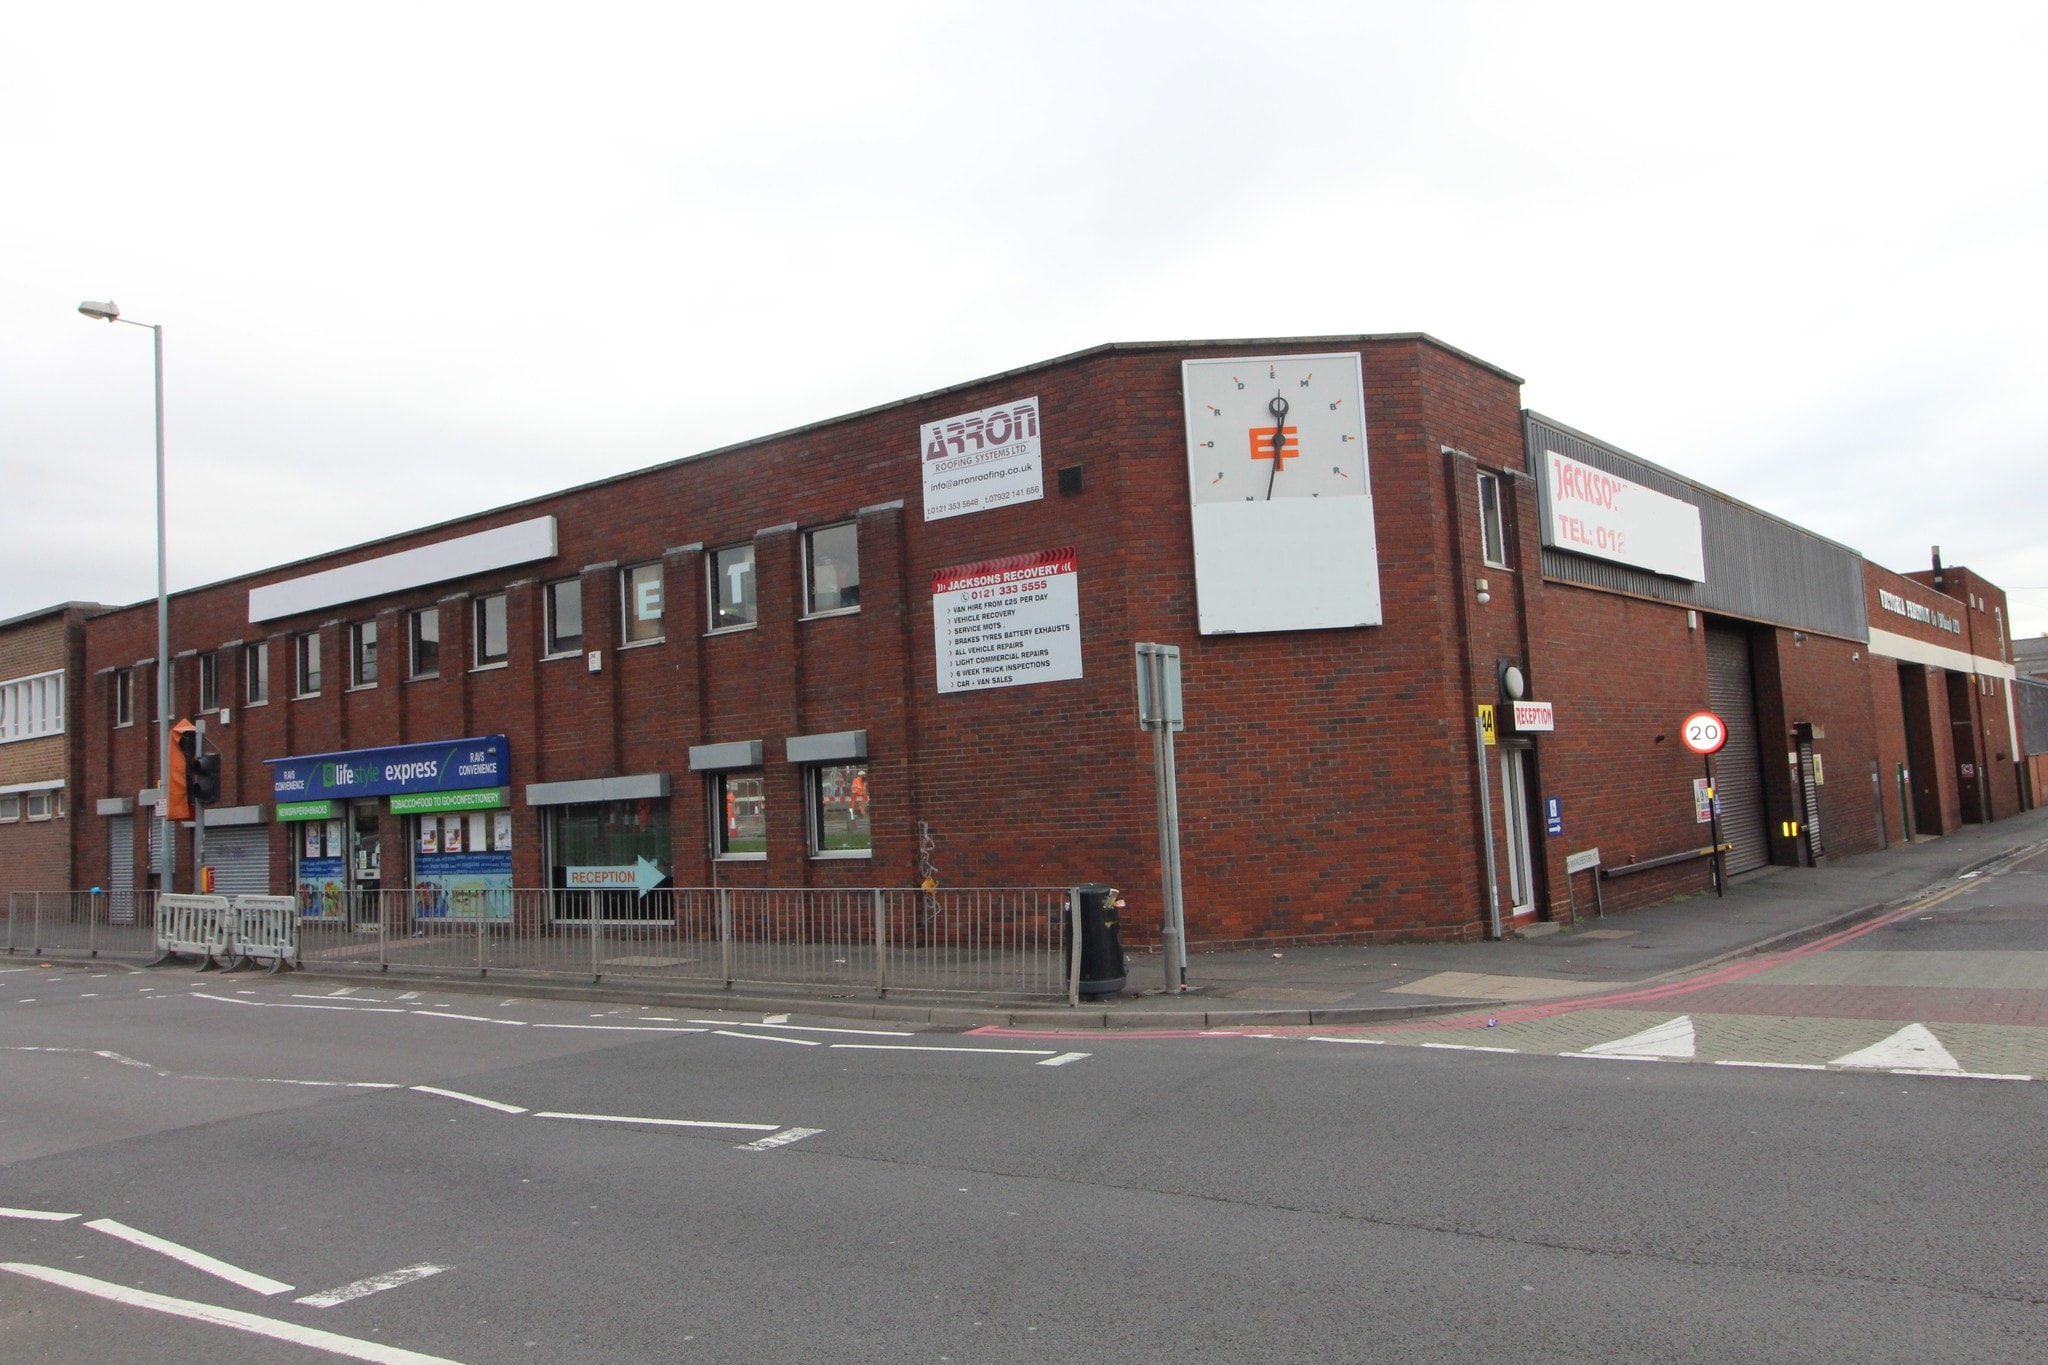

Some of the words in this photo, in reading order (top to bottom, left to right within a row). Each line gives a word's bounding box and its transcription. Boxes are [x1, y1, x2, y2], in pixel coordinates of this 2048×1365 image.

[926, 404, 1037, 461] ARRON
[935, 457, 973, 472] ROOFING
[975, 447, 1010, 463] SYSTEMS
[1011, 444, 1027, 455] LTD
[930, 463, 1033, 491] info@arronroofing.co.uk
[948, 501, 961, 511] 353
[1012, 489, 1024, 498] 141
[1026, 485, 1040, 495] 656
[1558, 514, 1593, 546] TEL:
[947, 573, 1001, 592] JACKSONS
[1003, 563, 1059, 582] RECOVERY
[971, 588, 996, 600] 0121
[999, 584, 1018, 595] 333
[1021, 580, 1047, 592] 5555
[638, 580, 662, 621] E
[953, 605, 966, 613] VAN
[967, 603, 983, 611] HIRE
[984, 600, 1003, 609] FROM
[1004, 597, 1018, 606] £25
[1020, 595, 1033, 604] PER
[1034, 593, 1048, 601] DAY
[953, 614, 980, 624] VEHICLE
[981, 609, 1016, 620] RECOVERY
[954, 624, 981, 634] SERVICE
[982, 622, 1002, 631] MOTS
[954, 635, 980, 645] BRAKES
[982, 632, 1003, 642] TYRES
[1004, 629, 1033, 639] BATTERY
[1034, 624, 1070, 635] EXHAUSTS
[955, 648, 967, 656] ALL
[967, 644, 995, 654] VEHICLE
[996, 641, 1024, 651] REPAIRS
[955, 658, 974, 667] LIGHT
[975, 652, 1020, 664] COMMERCIAL
[1021, 649, 1049, 658] REPAIRS
[962, 668, 980, 676] WEEK
[982, 665, 1004, 674] TRUCK
[1005, 660, 1051, 671] INSPECTIONS
[956, 680, 970, 688] CAR
[977, 678, 991, 686] VAN
[991, 675, 1013, 684] SALES
[1516, 707, 1552, 726] RECEPTION
[1689, 724, 1718, 741] 20
[335, 761, 380, 788] lifestyle
[385, 760, 438, 785] express
[459, 763, 497, 776] CONVENIENCE
[434, 796, 442, 806] TO
[571, 871, 636, 884] RECEPTION
